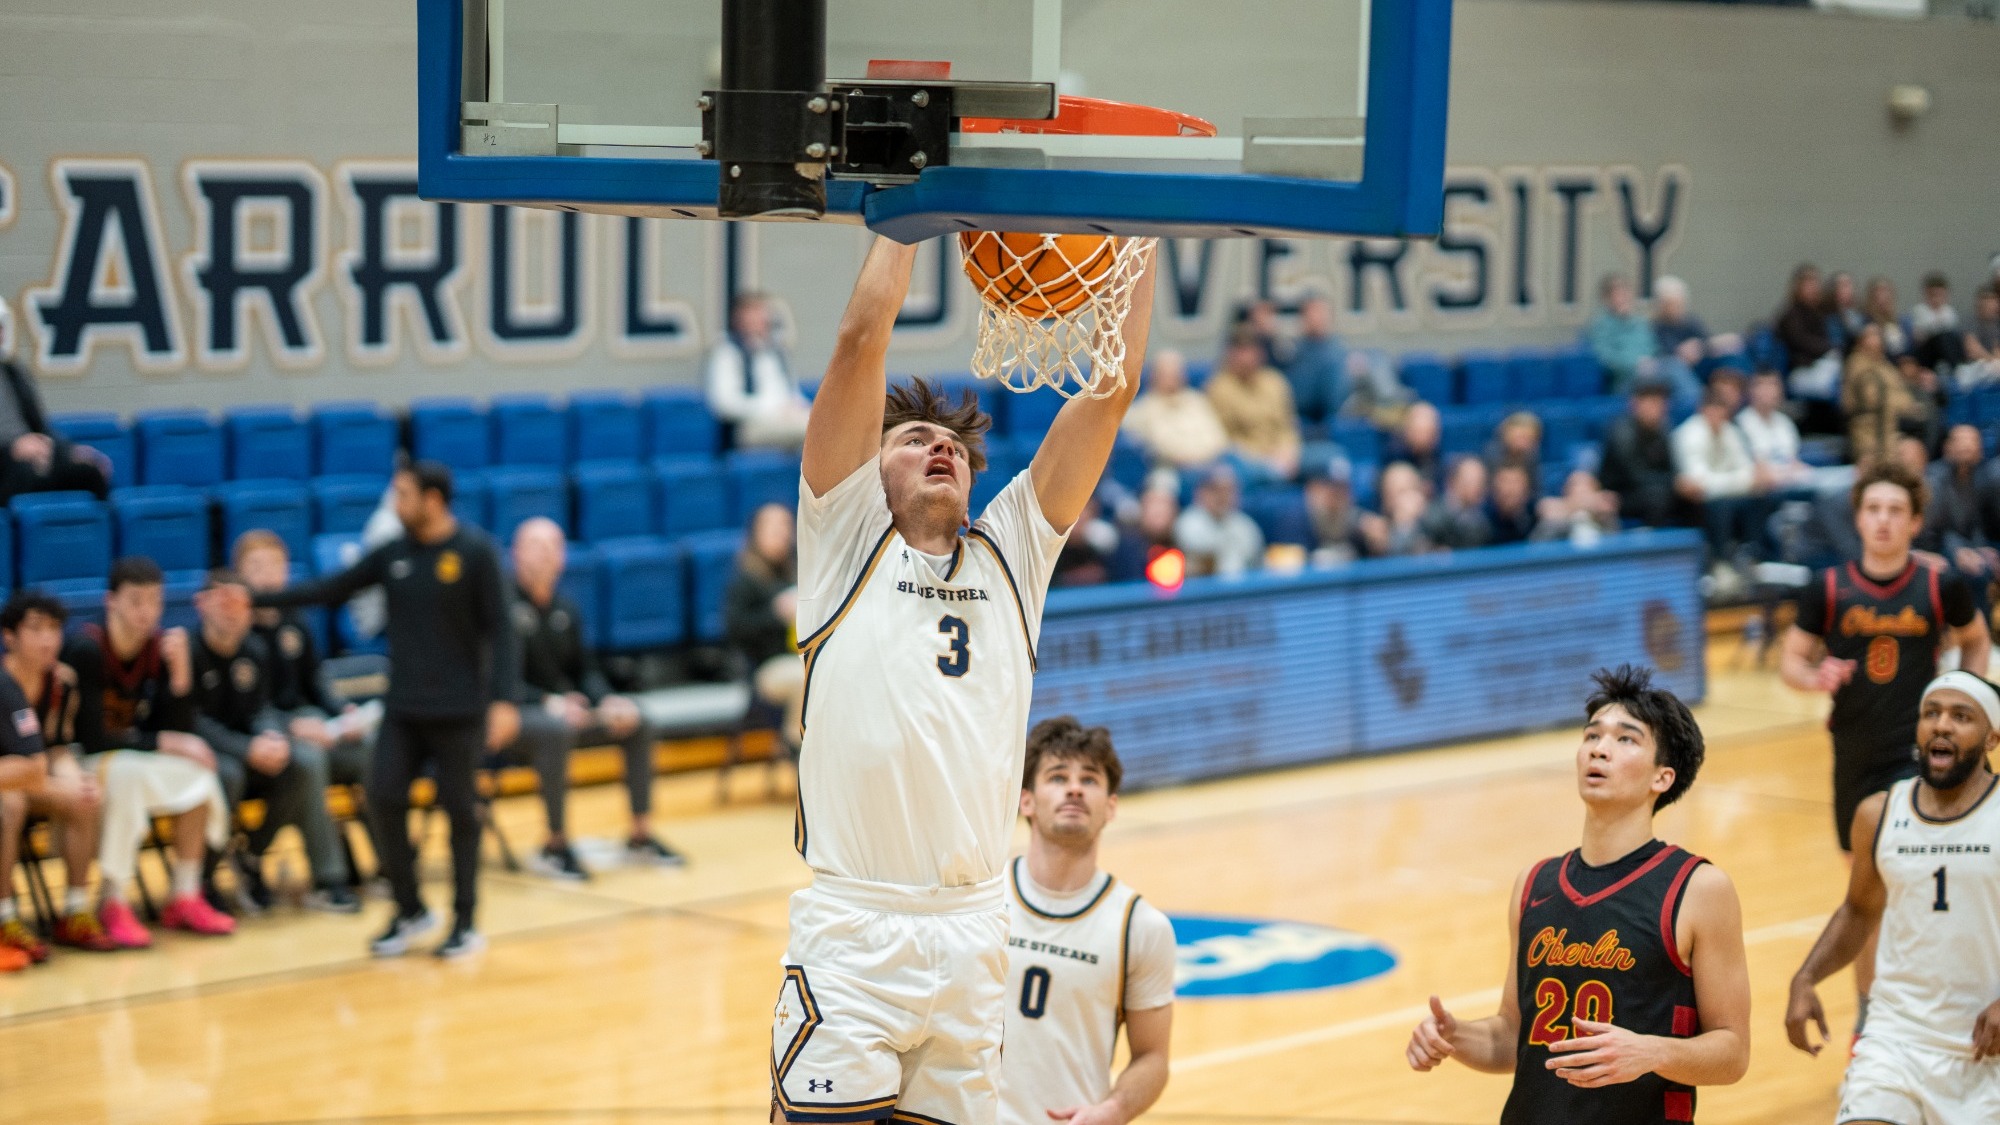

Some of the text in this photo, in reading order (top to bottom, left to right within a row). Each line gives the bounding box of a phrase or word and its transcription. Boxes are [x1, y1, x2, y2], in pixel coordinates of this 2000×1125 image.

[483, 132, 497, 146] #2
[0, 155, 760, 375] ARROL
[896, 580, 990, 601] BLUE STREA
[936, 613, 971, 678] 3
[1897, 843, 1991, 854] BLUE STREAKS
[1932, 865, 1949, 912] 1
[1008, 937, 1100, 965] UE STREAKS
[1527, 926, 1636, 971] Oberlin
[1019, 965, 1052, 1020] 0
[1528, 977, 1614, 1048] 20
